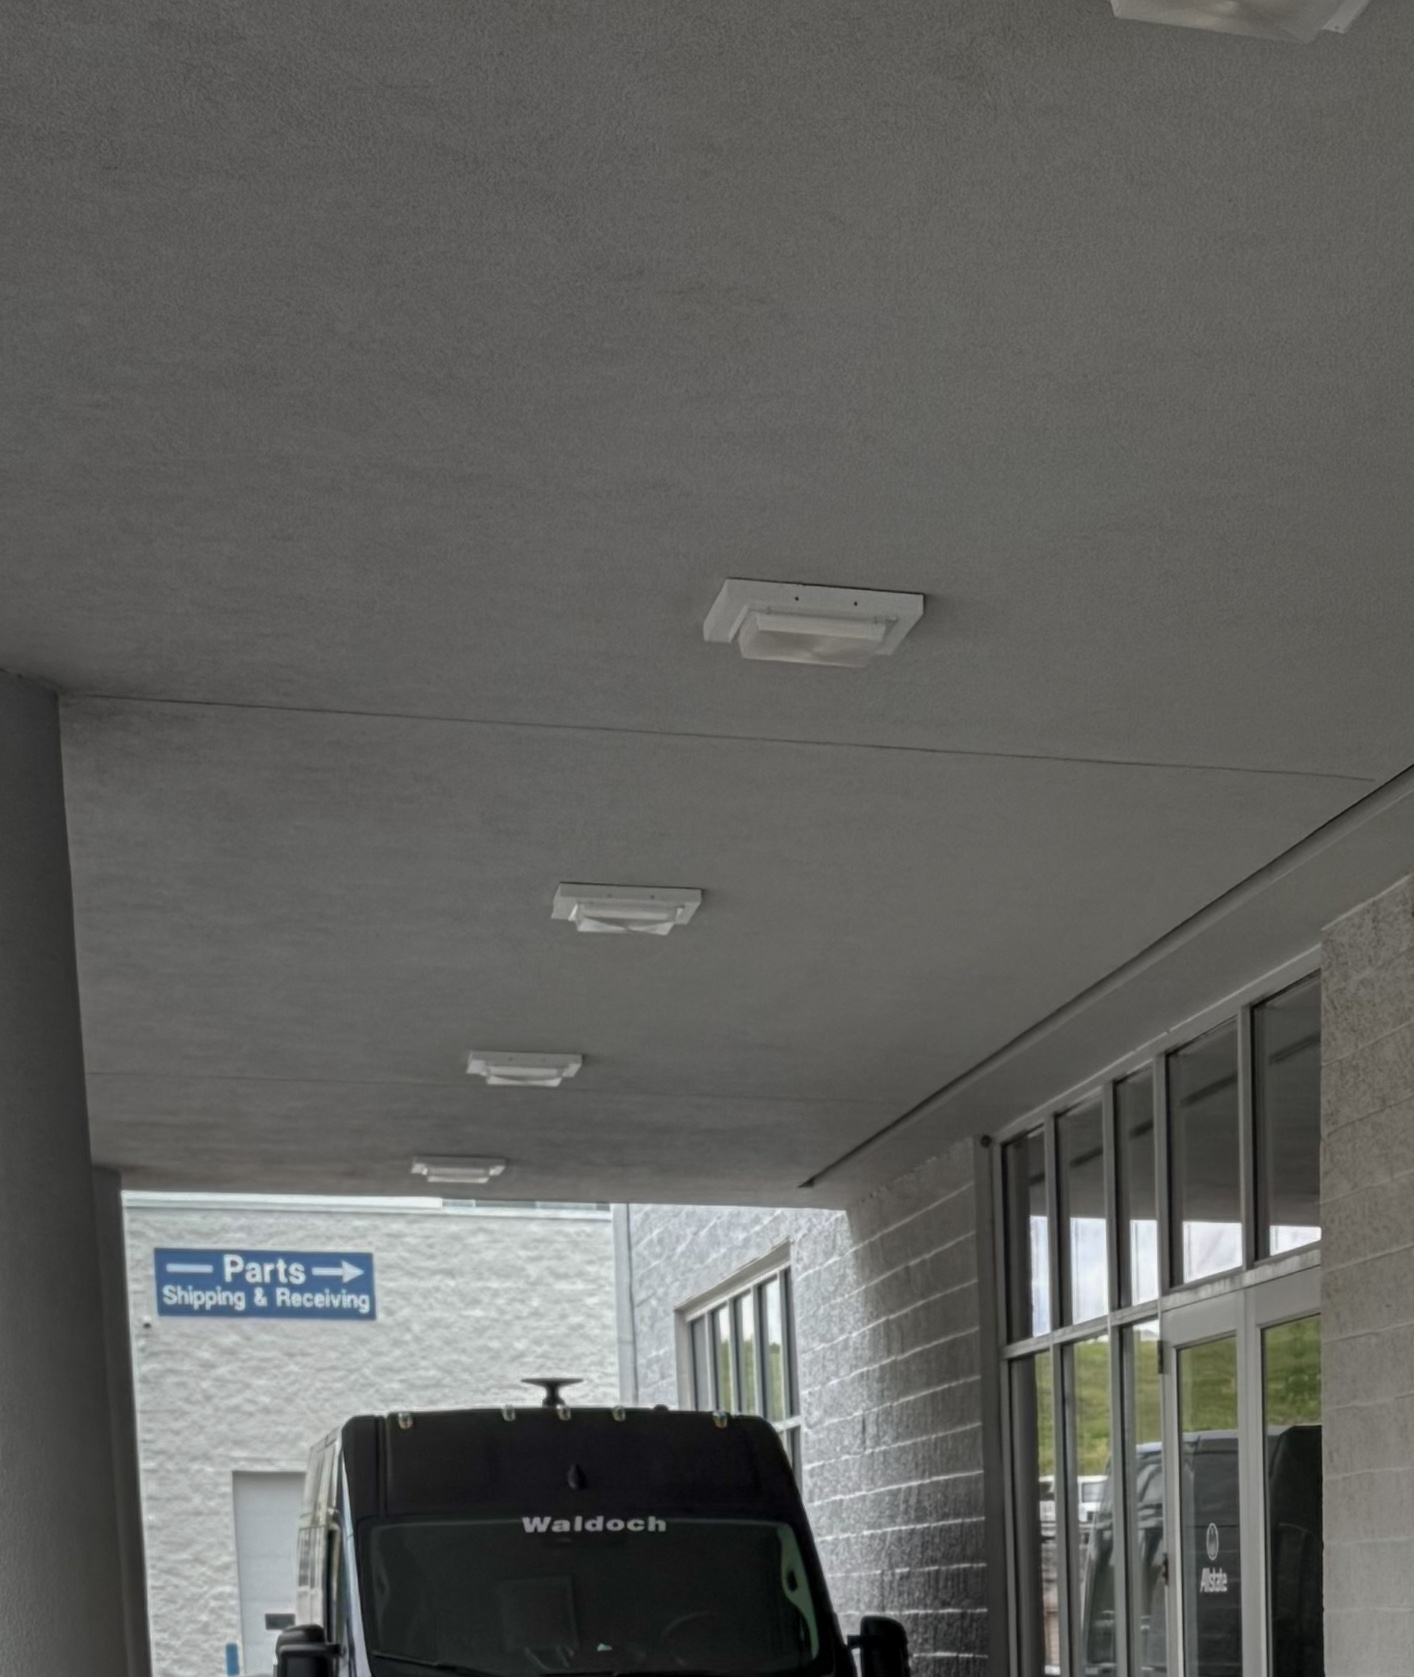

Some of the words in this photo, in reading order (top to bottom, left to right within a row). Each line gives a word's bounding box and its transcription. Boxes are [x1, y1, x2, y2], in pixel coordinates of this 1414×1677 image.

[223, 1254, 306, 1284] Parts
[162, 1284, 246, 1311] Shipping
[253, 1286, 268, 1307] &
[275, 1286, 371, 1314] Receiving
[522, 1515, 667, 1533] Waldoch
[1200, 1567, 1228, 1593] Allstate
